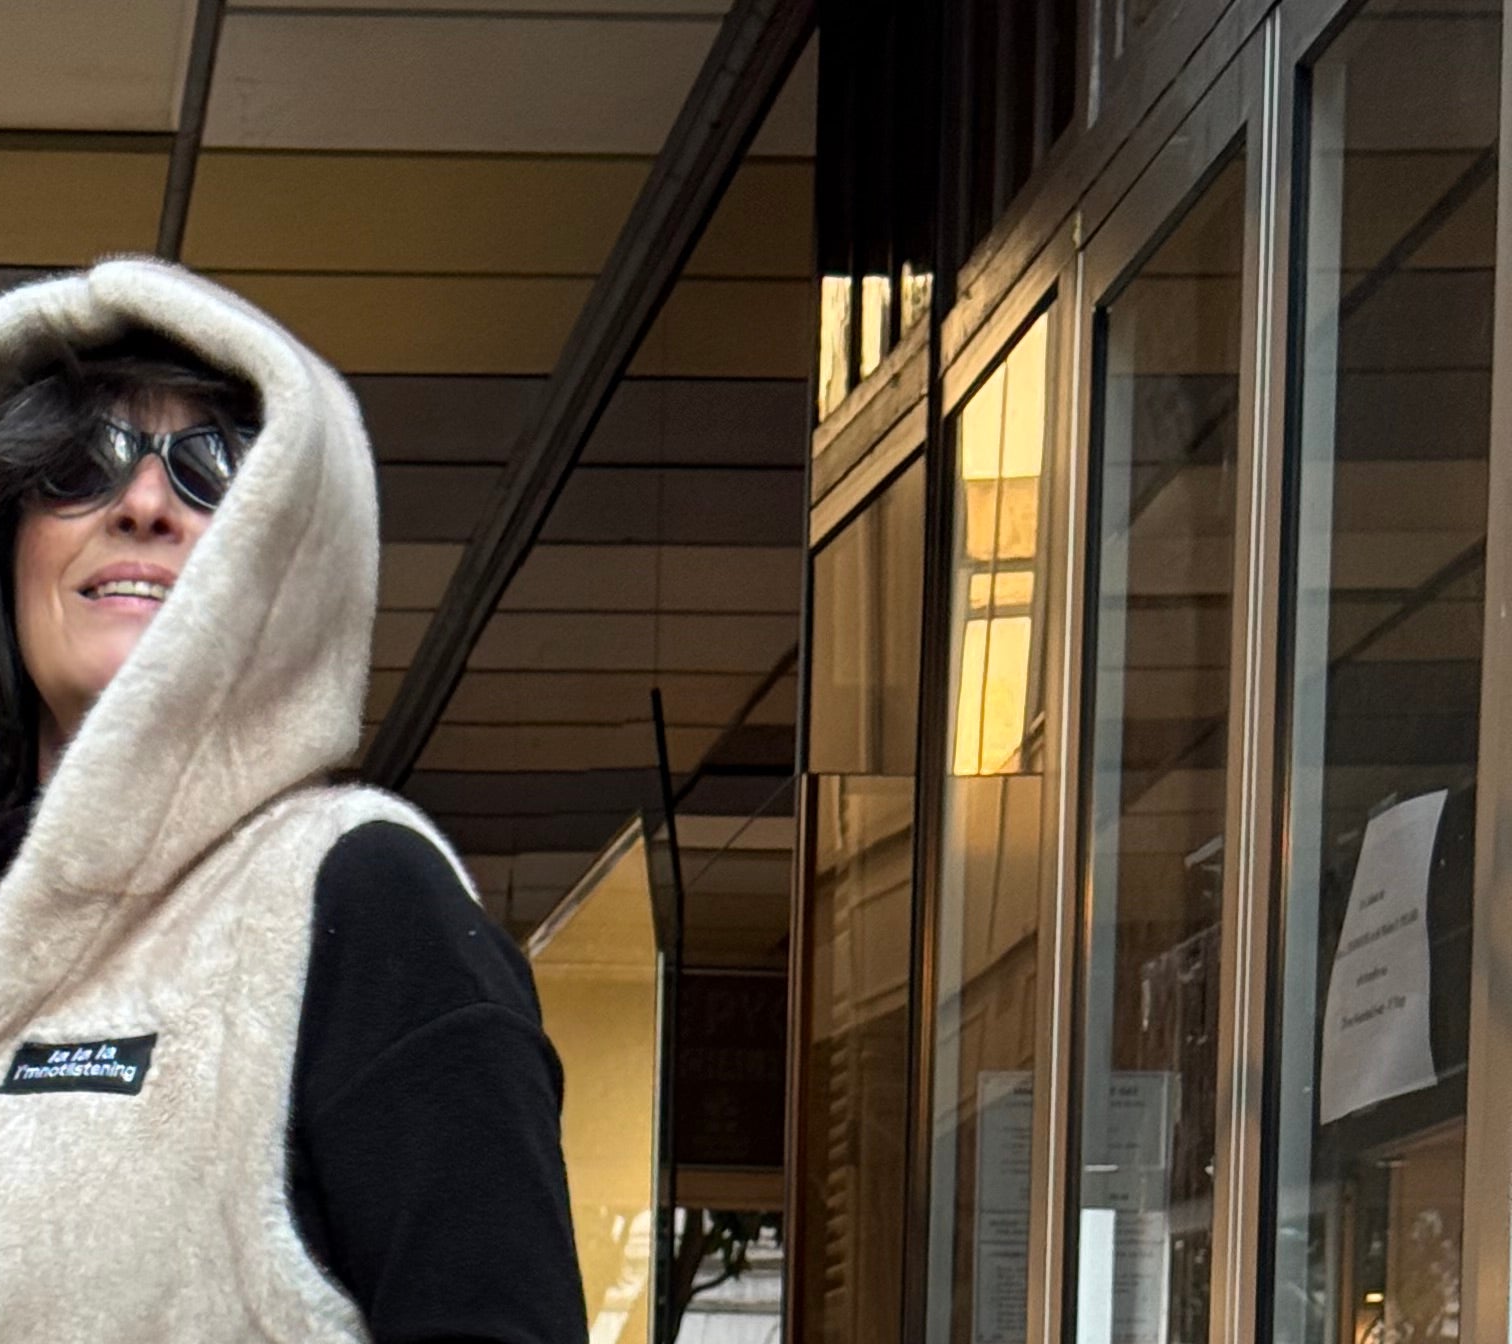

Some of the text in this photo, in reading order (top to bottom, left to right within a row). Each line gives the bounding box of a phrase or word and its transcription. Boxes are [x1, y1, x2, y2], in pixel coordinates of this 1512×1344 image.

[47, 1044, 117, 1063] la la la
